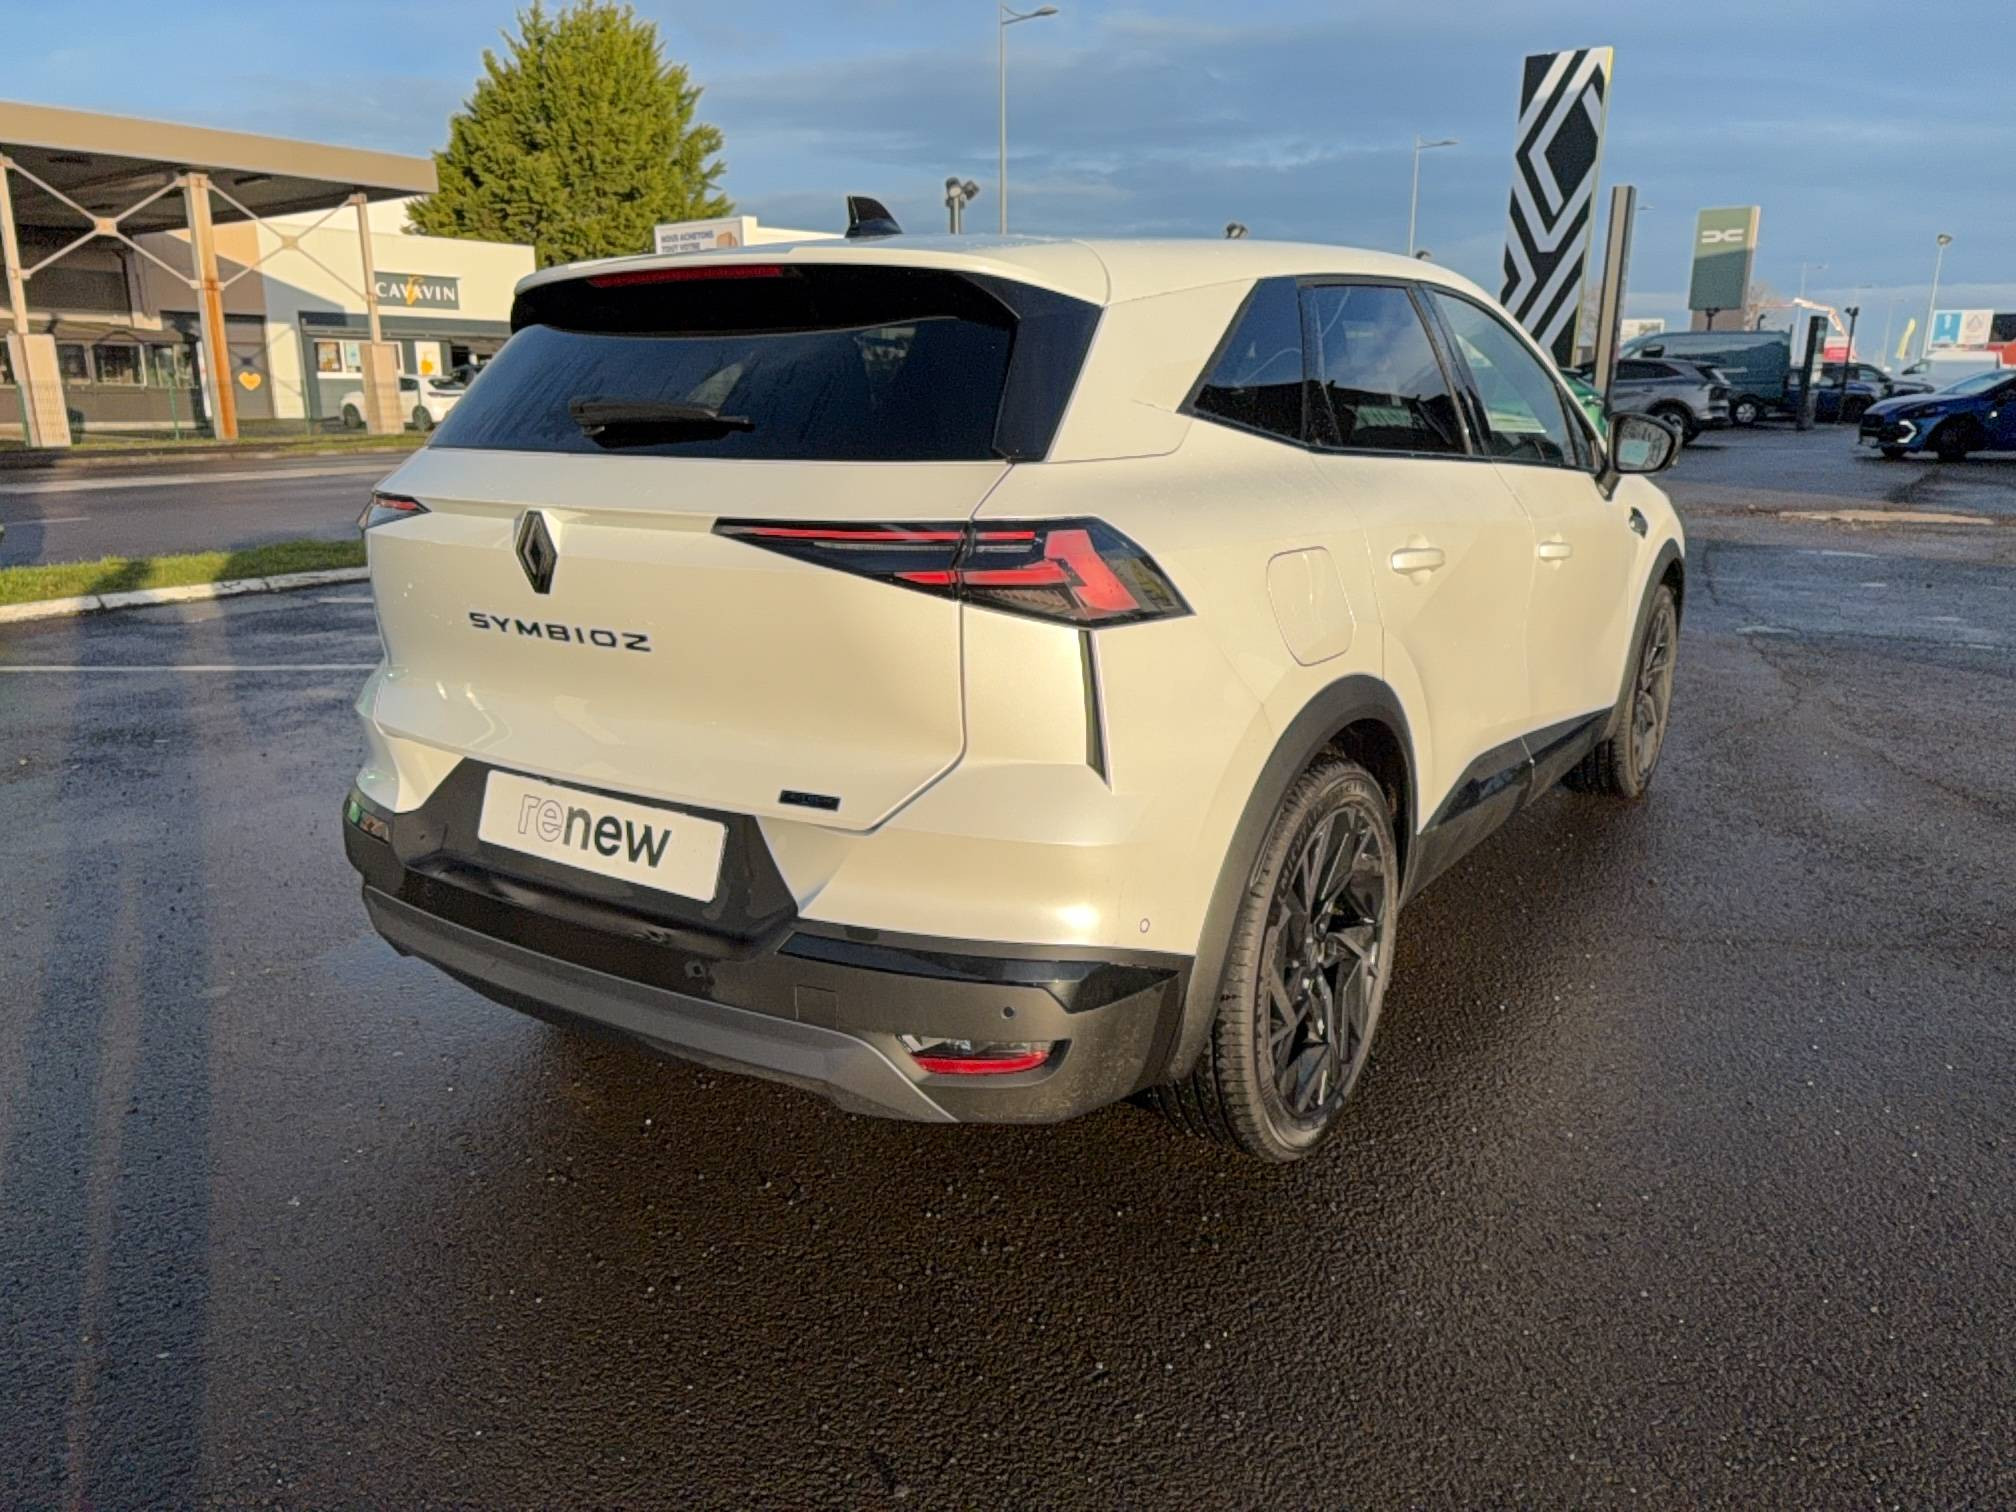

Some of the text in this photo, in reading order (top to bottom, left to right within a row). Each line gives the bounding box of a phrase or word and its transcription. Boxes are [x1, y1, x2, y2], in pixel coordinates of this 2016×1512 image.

[375, 281, 456, 301] CAVAVIN
[468, 611, 652, 652] SYMBIOZ
[517, 793, 673, 869] renew
